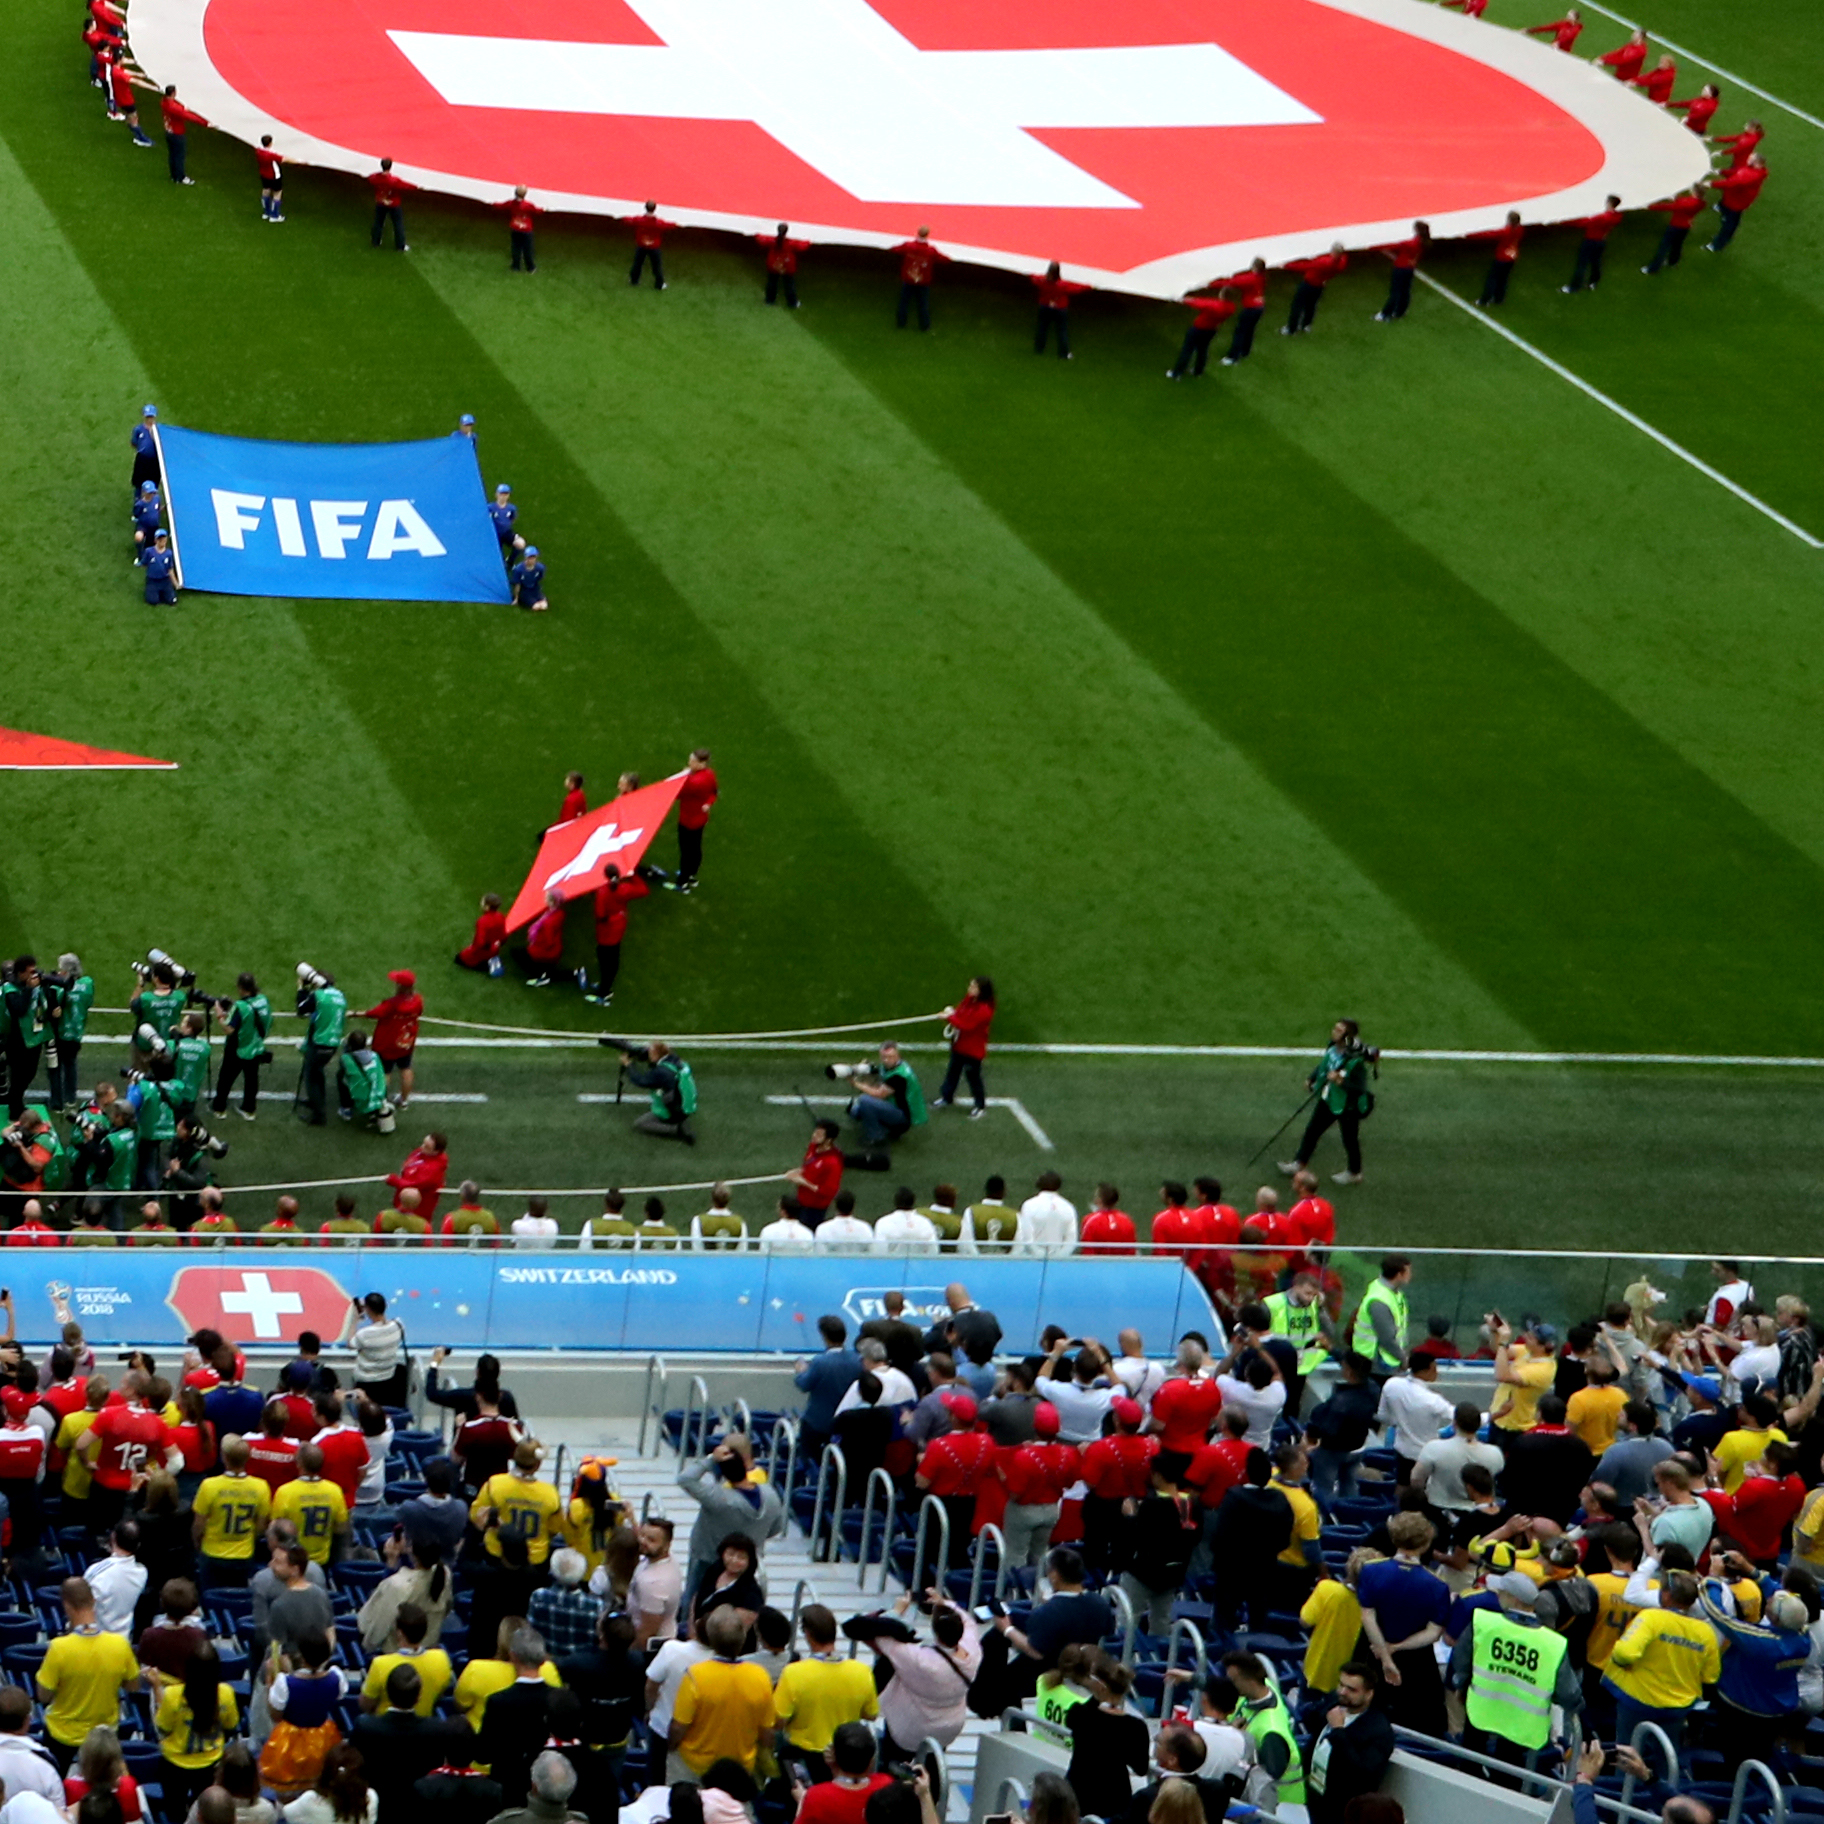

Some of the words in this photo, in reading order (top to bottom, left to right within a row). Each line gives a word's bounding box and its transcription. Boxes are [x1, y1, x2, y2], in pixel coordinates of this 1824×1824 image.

[210, 488, 447, 560] FIFA
[498, 1266, 678, 1286] SWITZERLAND
[75, 1292, 132, 1304] RUSSIA
[79, 1304, 115, 1316] 2018
[221, 1503, 256, 1534] 12
[300, 1505, 332, 1536] 18
[1490, 1637, 1540, 1672] 6358
[1487, 1663, 1537, 1686] STEWARD
